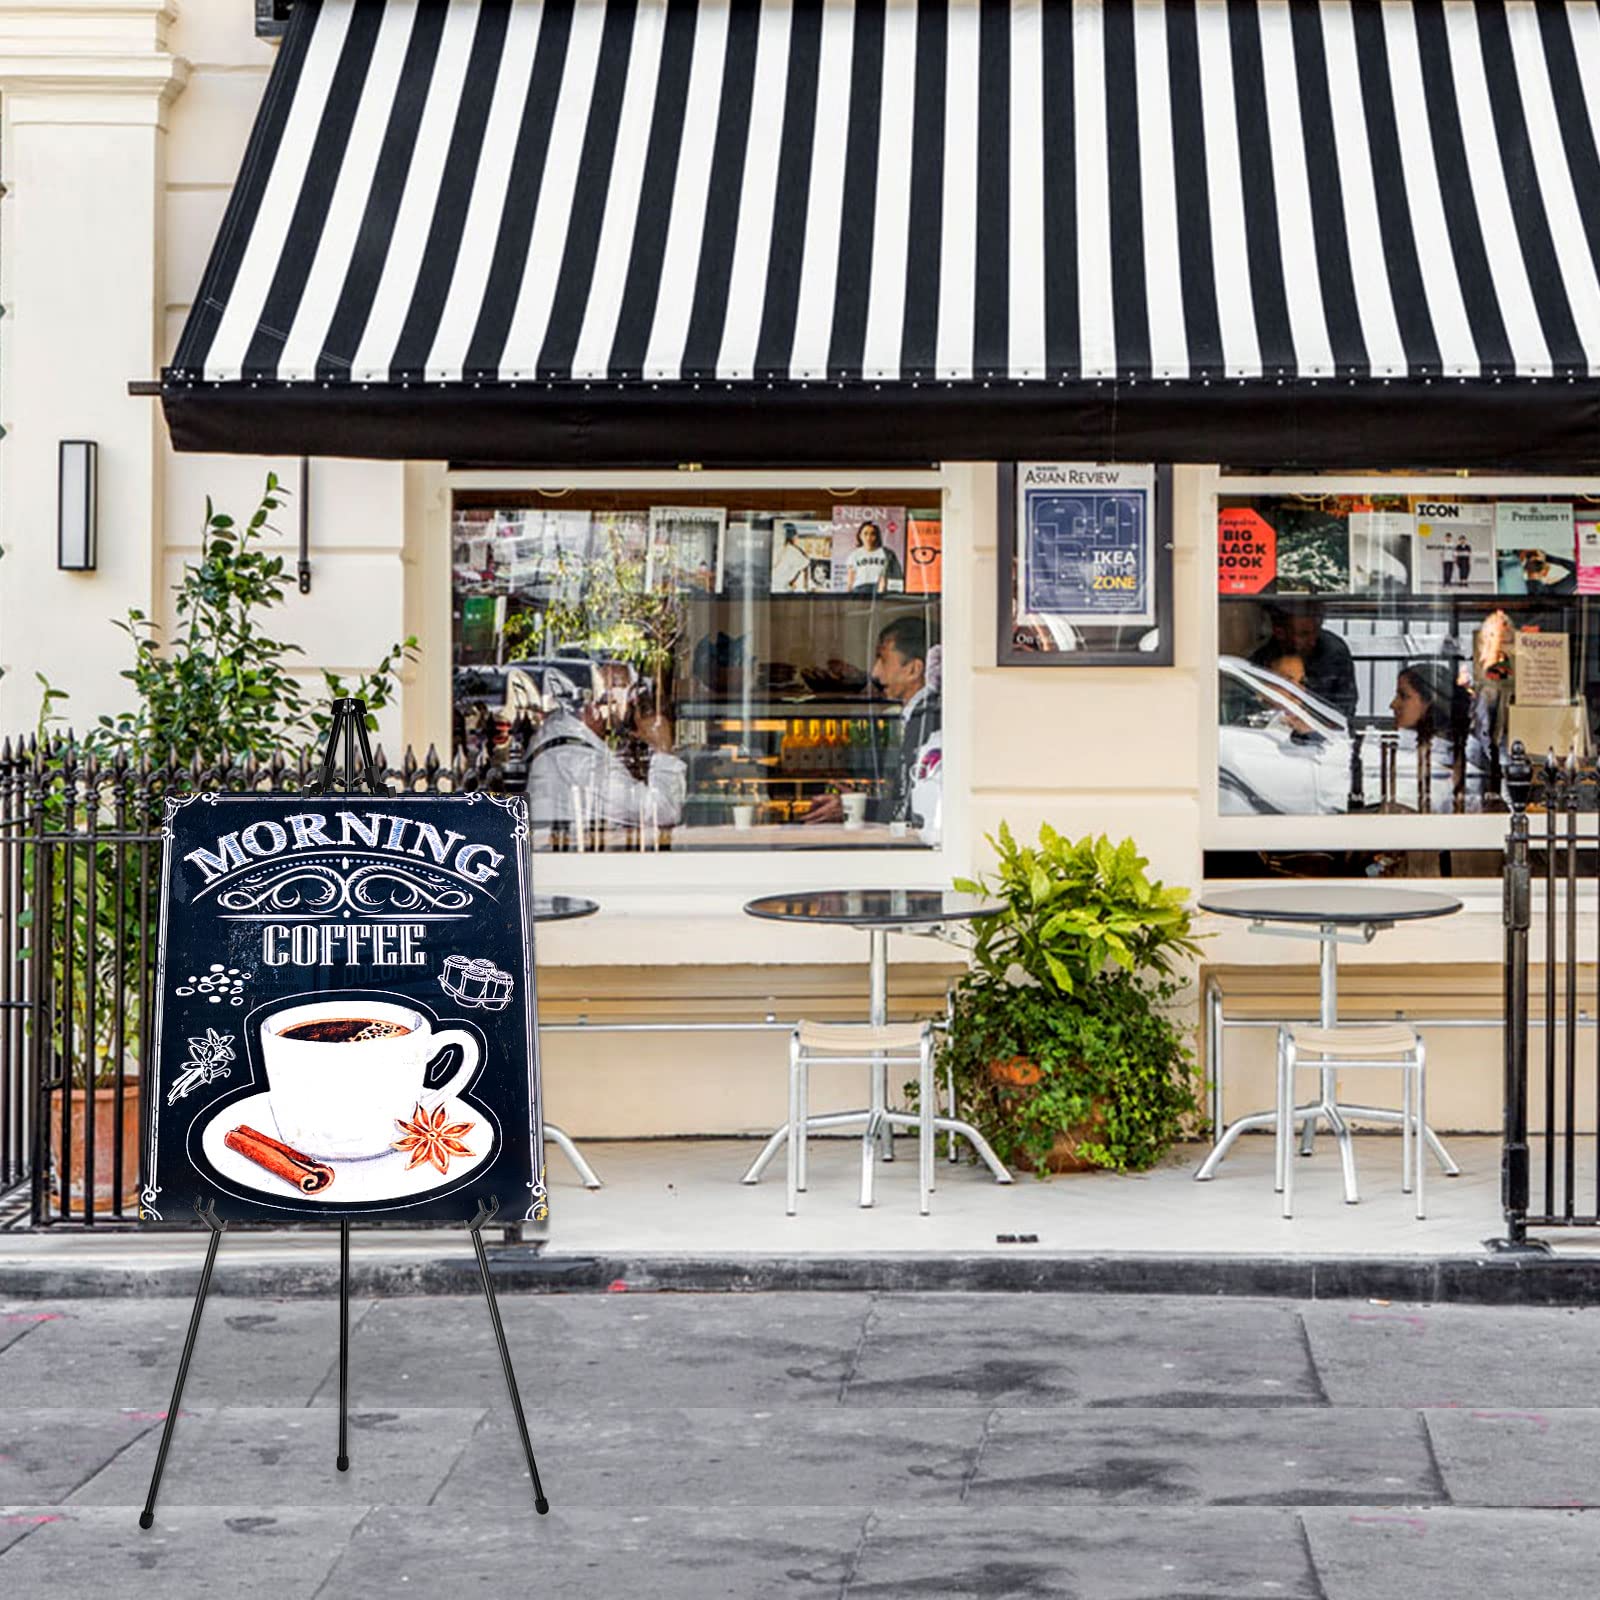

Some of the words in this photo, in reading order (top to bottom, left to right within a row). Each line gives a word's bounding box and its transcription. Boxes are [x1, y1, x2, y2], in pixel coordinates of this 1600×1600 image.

[1069, 470, 1120, 484] REVIEW
[843, 508, 887, 520] NEON
[1417, 504, 1459, 517] ICON
[1511, 511, 1558, 522] Premium
[1223, 530, 1253, 541] BIG
[1218, 543, 1267, 555] LACK
[1092, 550, 1136, 564] IKEA
[1092, 576, 1137, 590] ZONE
[184, 811, 504, 884] MORNING
[261, 924, 427, 967] COFFEE
